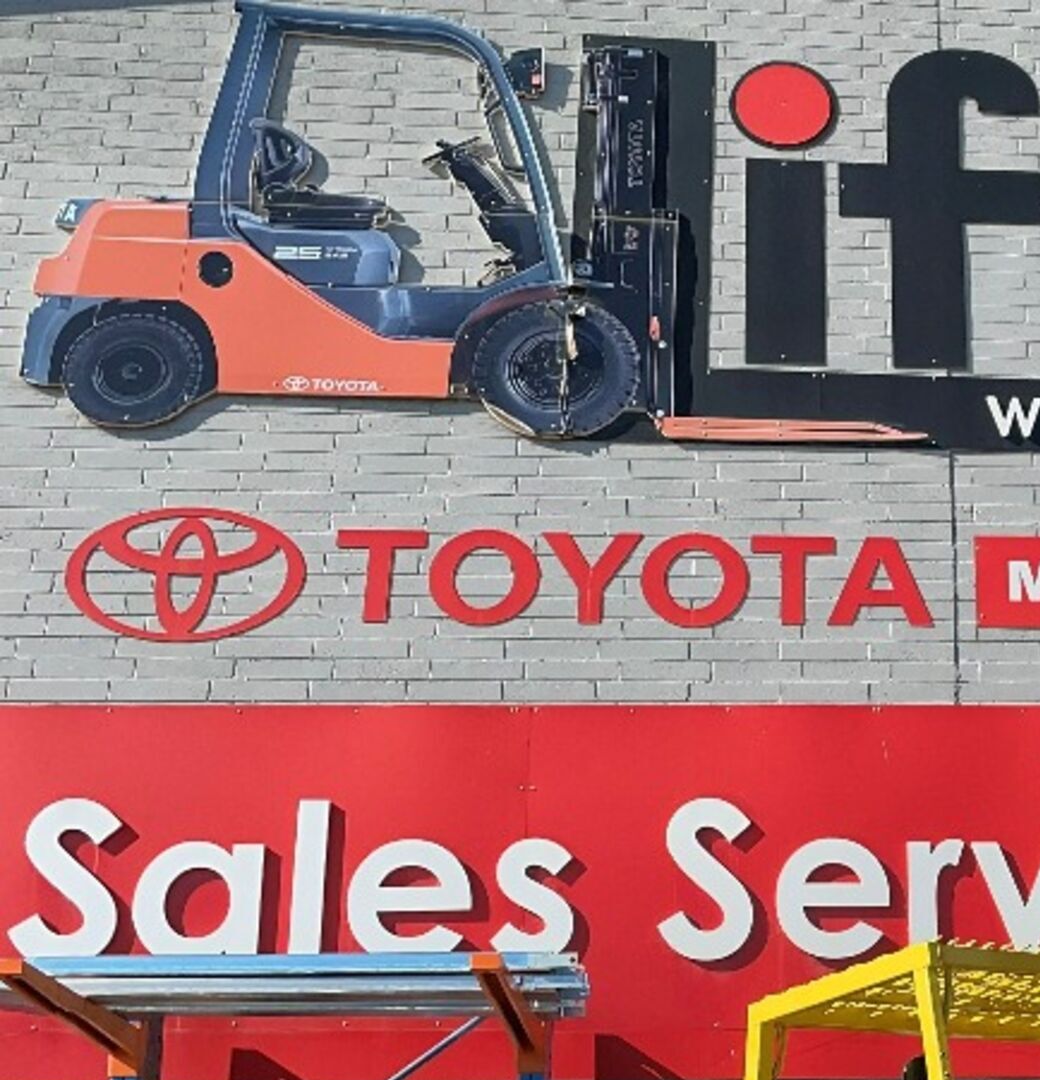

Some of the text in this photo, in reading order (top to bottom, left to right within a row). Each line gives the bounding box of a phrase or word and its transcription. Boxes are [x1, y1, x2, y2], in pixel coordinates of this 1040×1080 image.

[312, 378, 379, 392] TOYOTA
[336, 530, 934, 629] TOYOTA
[6, 798, 574, 957] Sales
